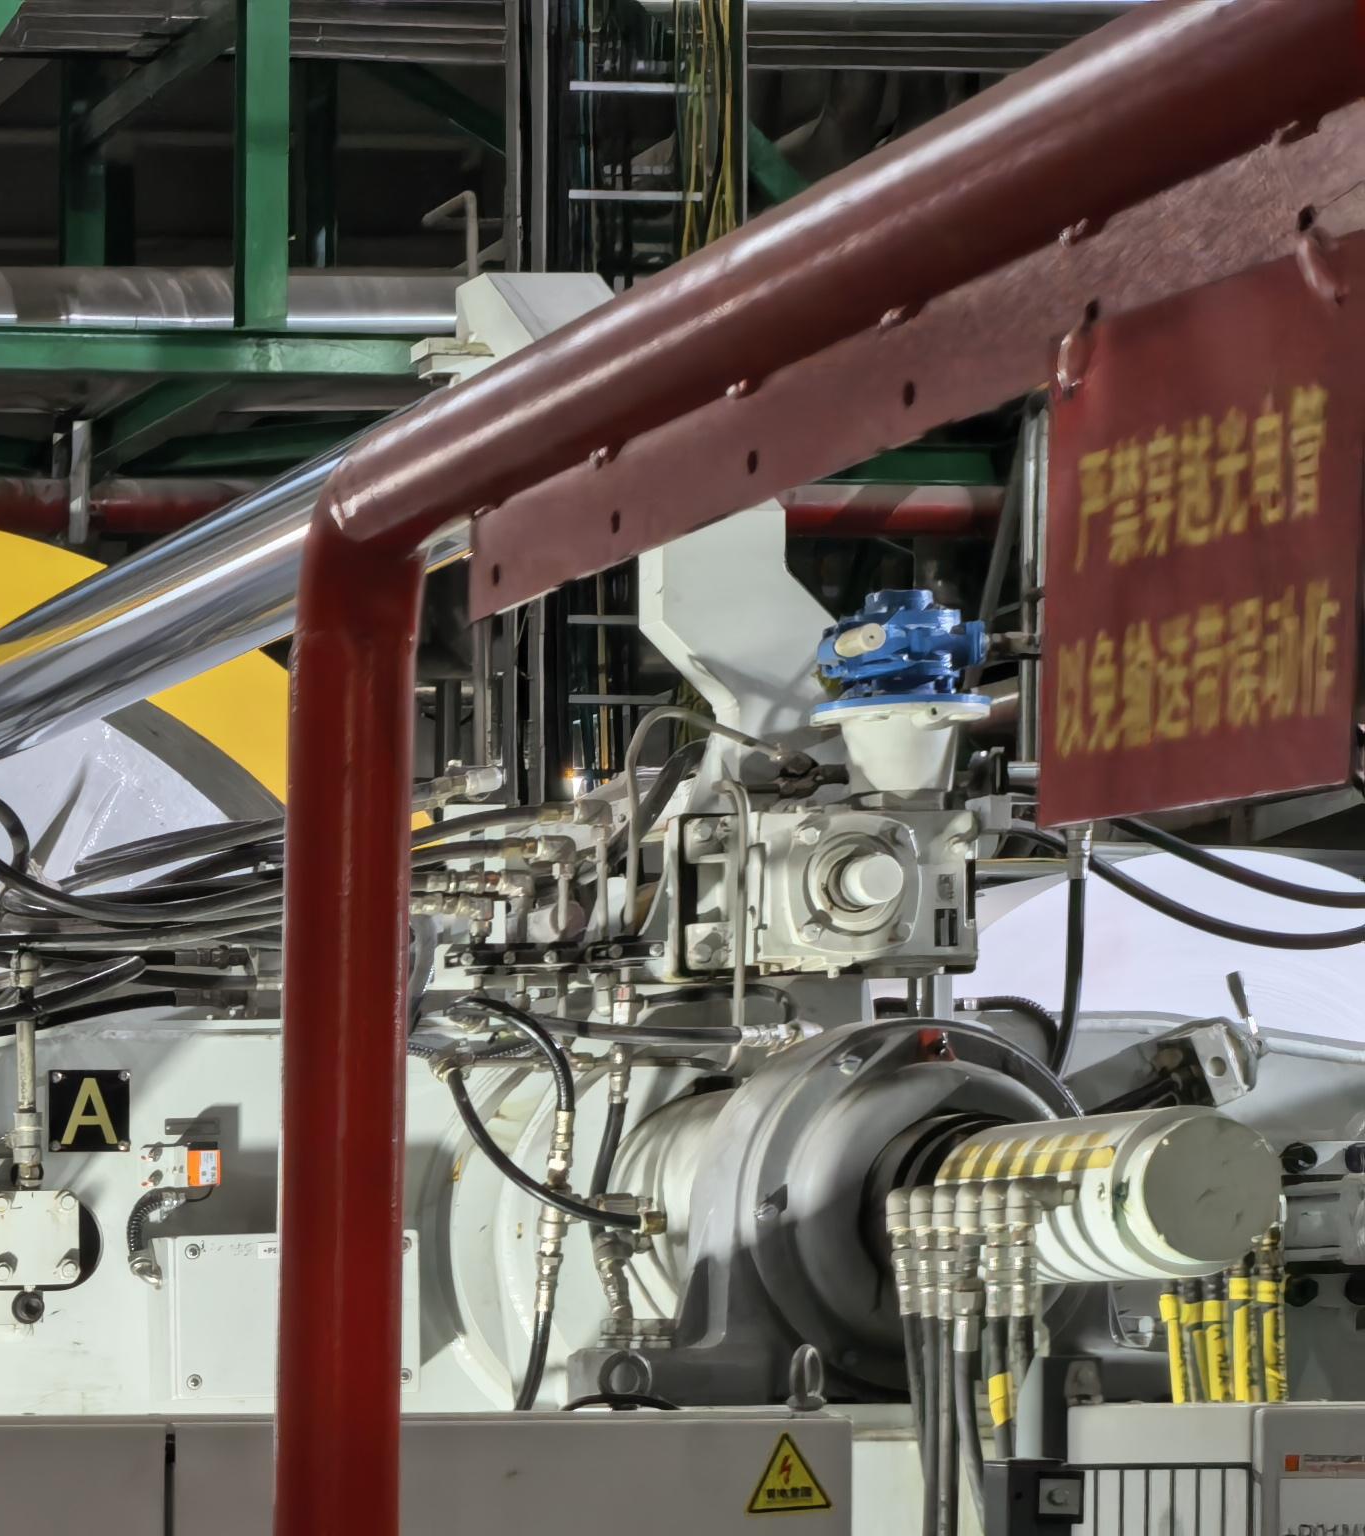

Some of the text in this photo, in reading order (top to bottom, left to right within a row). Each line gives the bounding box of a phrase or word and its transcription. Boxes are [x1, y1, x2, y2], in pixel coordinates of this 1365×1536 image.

[1075, 383, 1328, 573] 严禁穿越光电管
[1056, 577, 1340, 760] 以免输送带误动作
[60, 1076, 118, 1145] A
